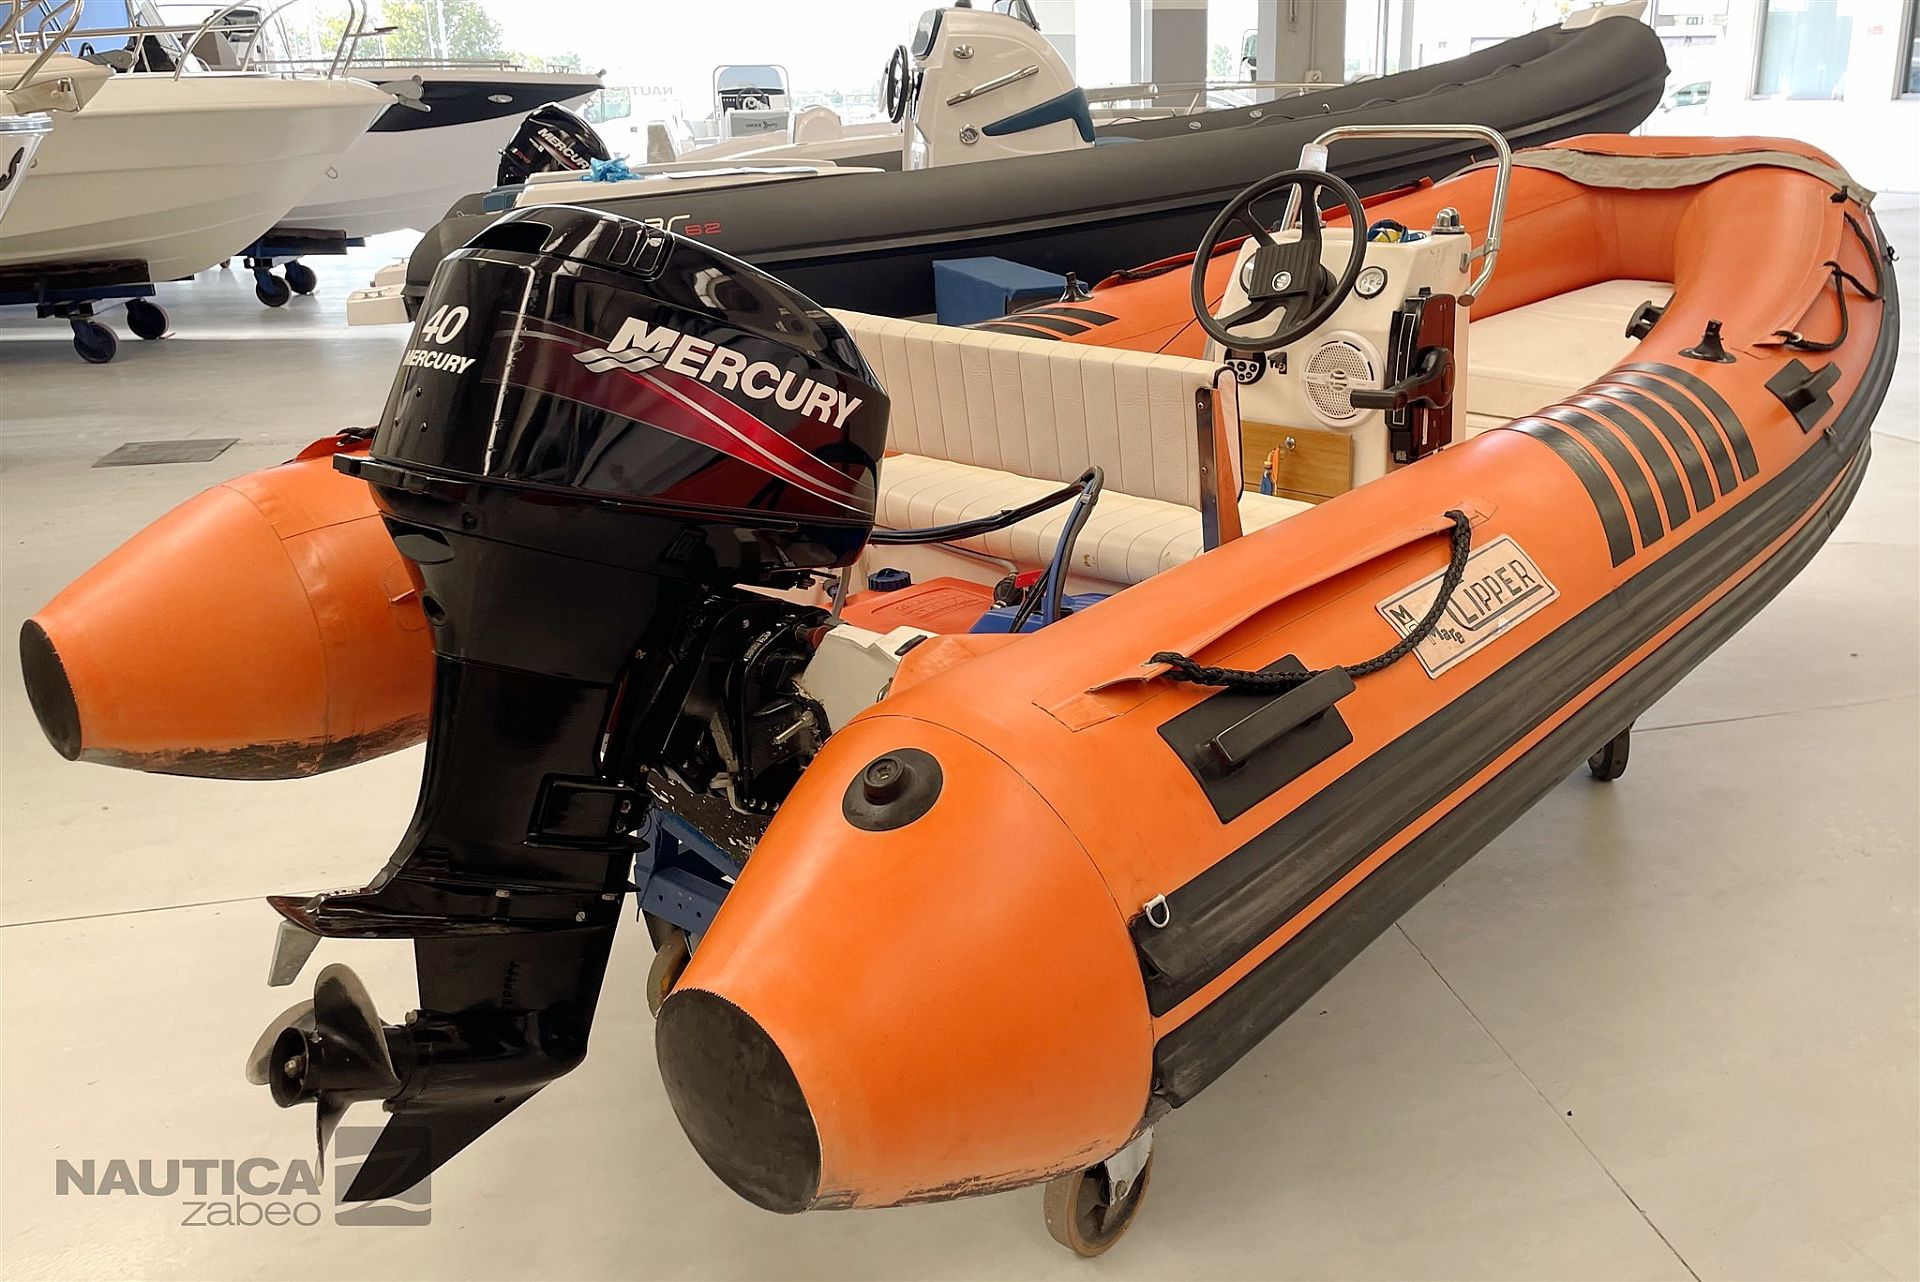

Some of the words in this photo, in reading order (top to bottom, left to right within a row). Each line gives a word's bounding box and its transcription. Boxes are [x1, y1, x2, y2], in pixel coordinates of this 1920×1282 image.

[537, 127, 592, 170] MERCUR
[421, 304, 470, 345] 40
[402, 349, 477, 374] MERCURY
[606, 316, 863, 429] MERCURY
